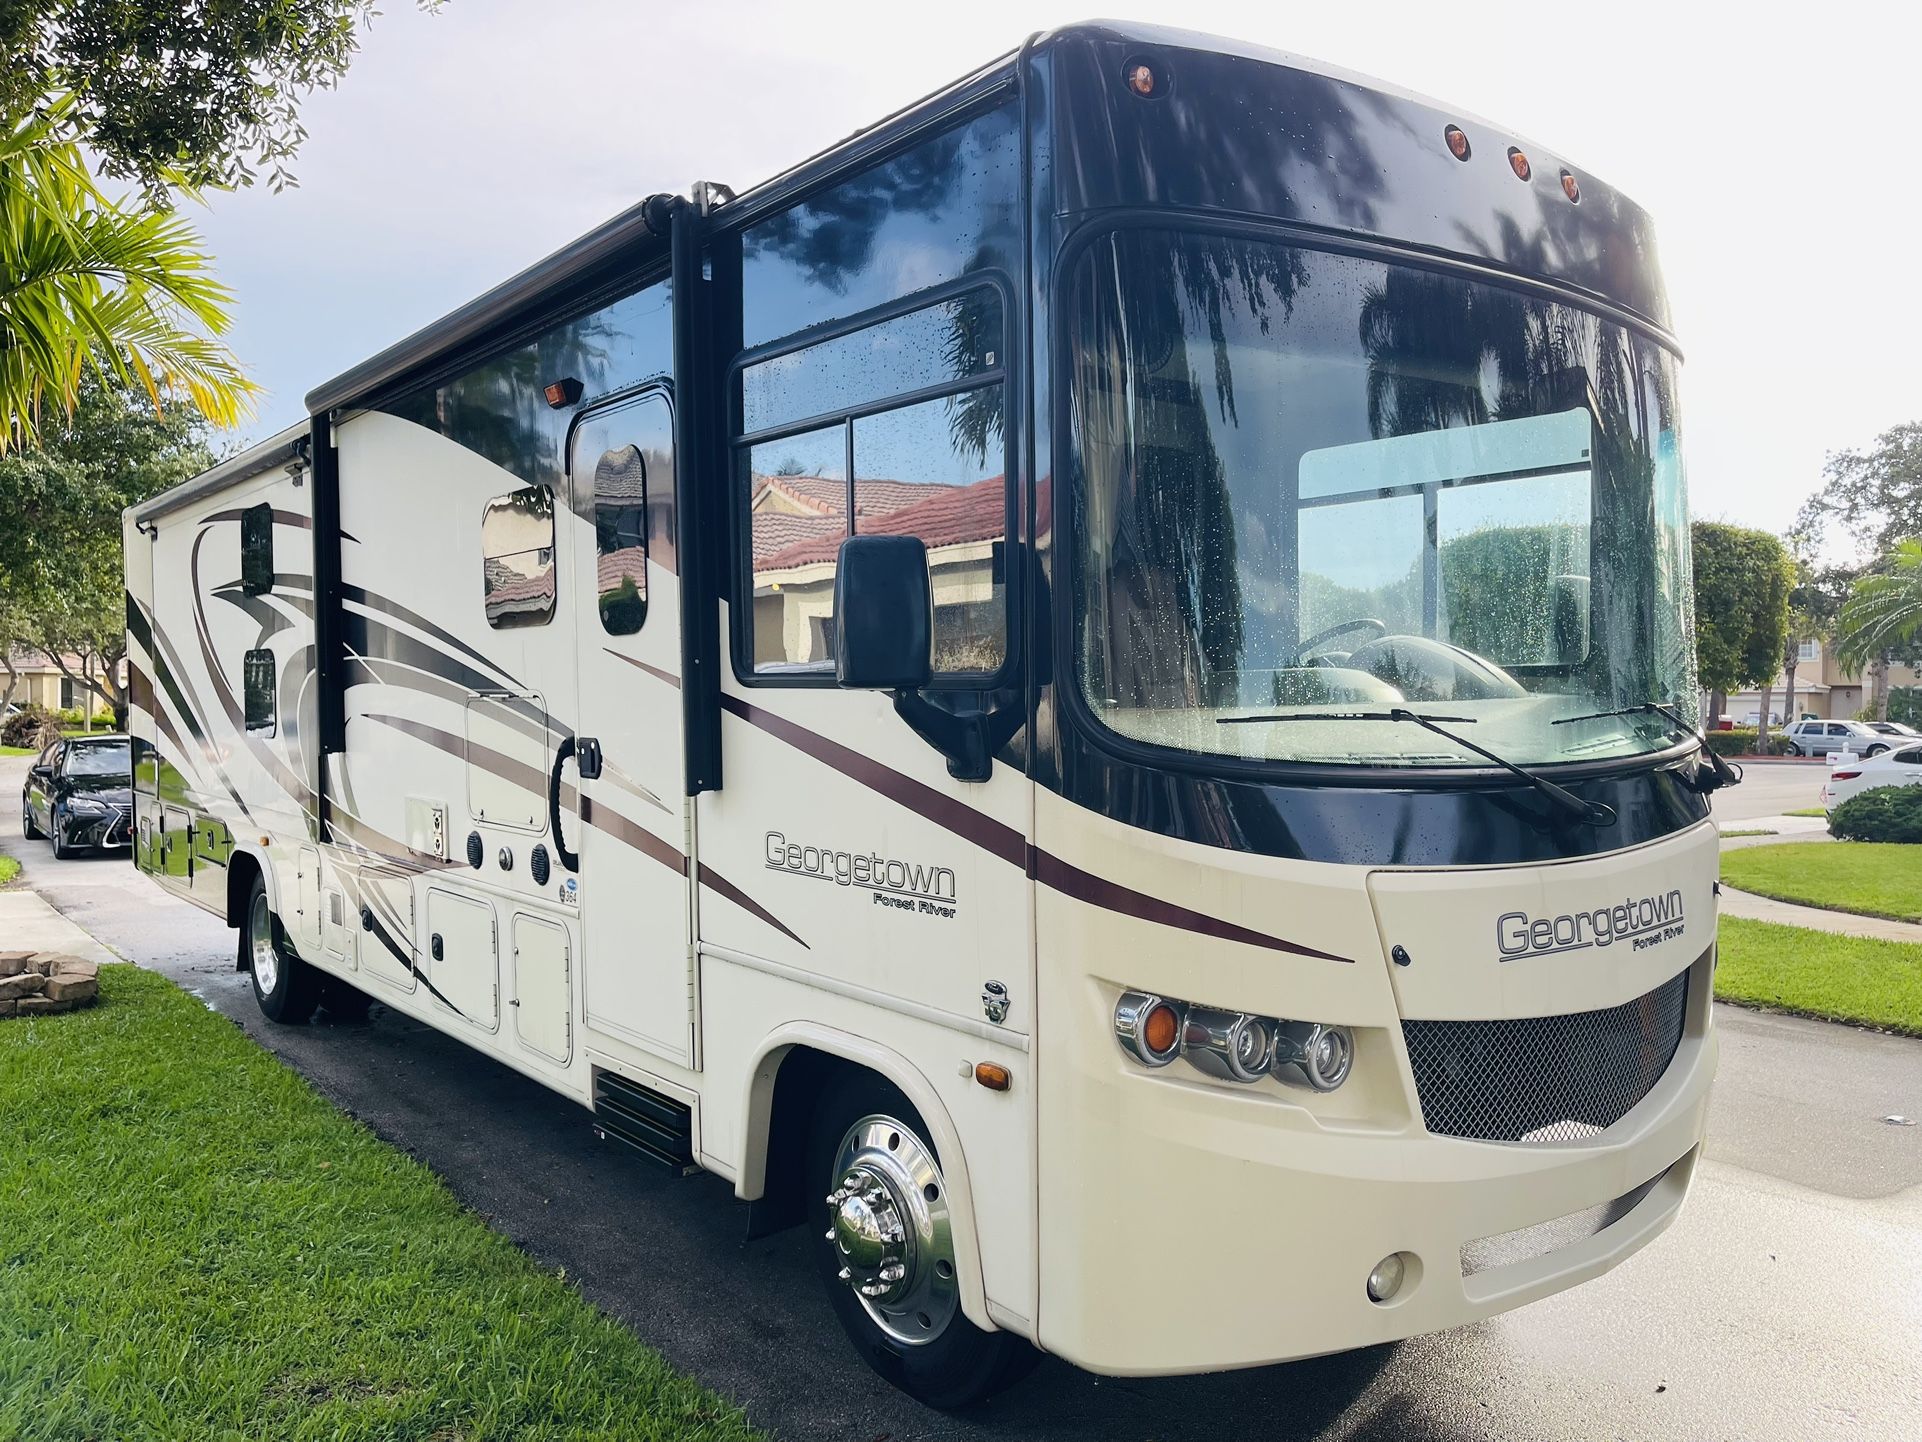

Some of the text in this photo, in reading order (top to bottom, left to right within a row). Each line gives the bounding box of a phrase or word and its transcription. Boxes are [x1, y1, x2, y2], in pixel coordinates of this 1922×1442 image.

[765, 831, 956, 898] Georgetown
[873, 892, 956, 918] Forest River
[1497, 889, 1684, 955] Georgetown
[1632, 924, 1685, 951] Forest River
